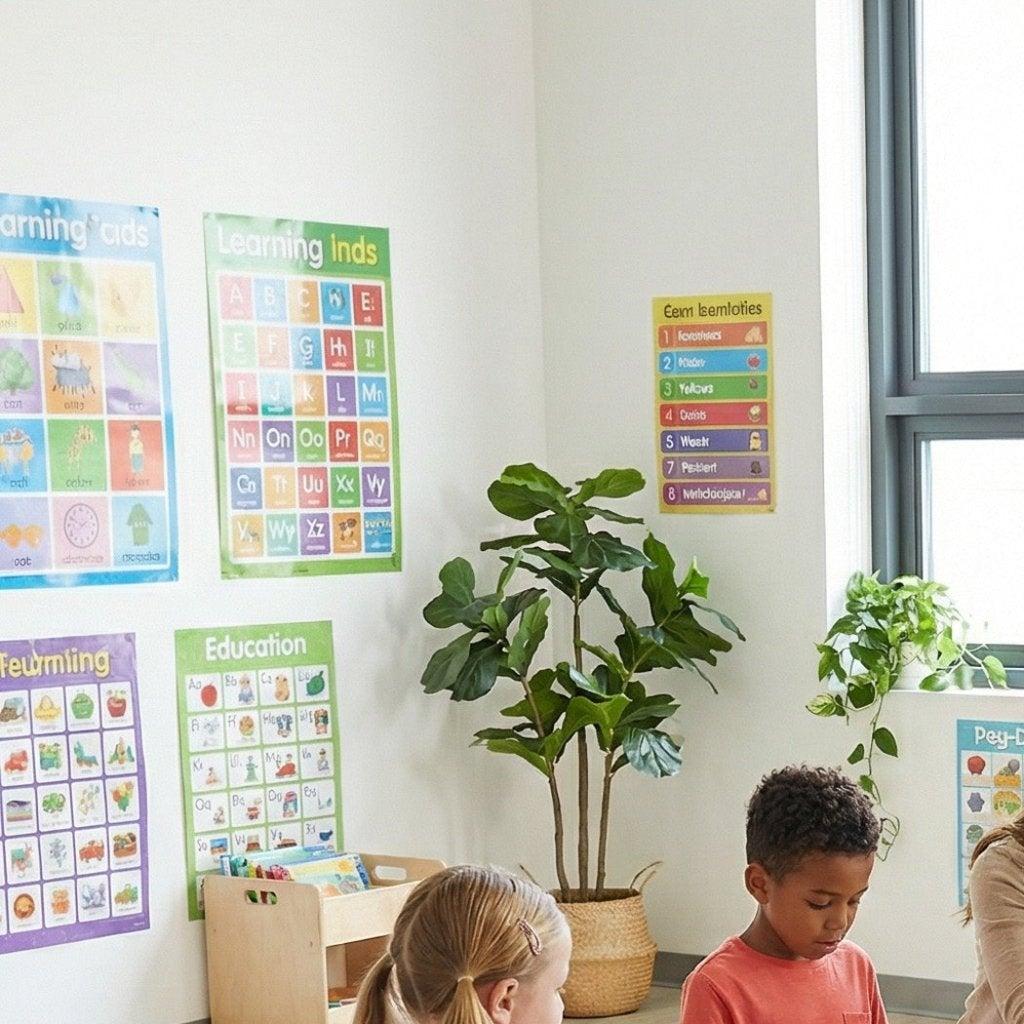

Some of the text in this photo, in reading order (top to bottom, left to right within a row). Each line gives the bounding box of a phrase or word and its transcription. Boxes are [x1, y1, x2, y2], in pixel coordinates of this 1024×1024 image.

[217, 224, 324, 270] Learning
[663, 356, 671, 370] 2
[663, 382, 672, 397] 3
[667, 460, 674, 475] 7
[668, 486, 676, 501] 8
[205, 633, 307, 662] Education
